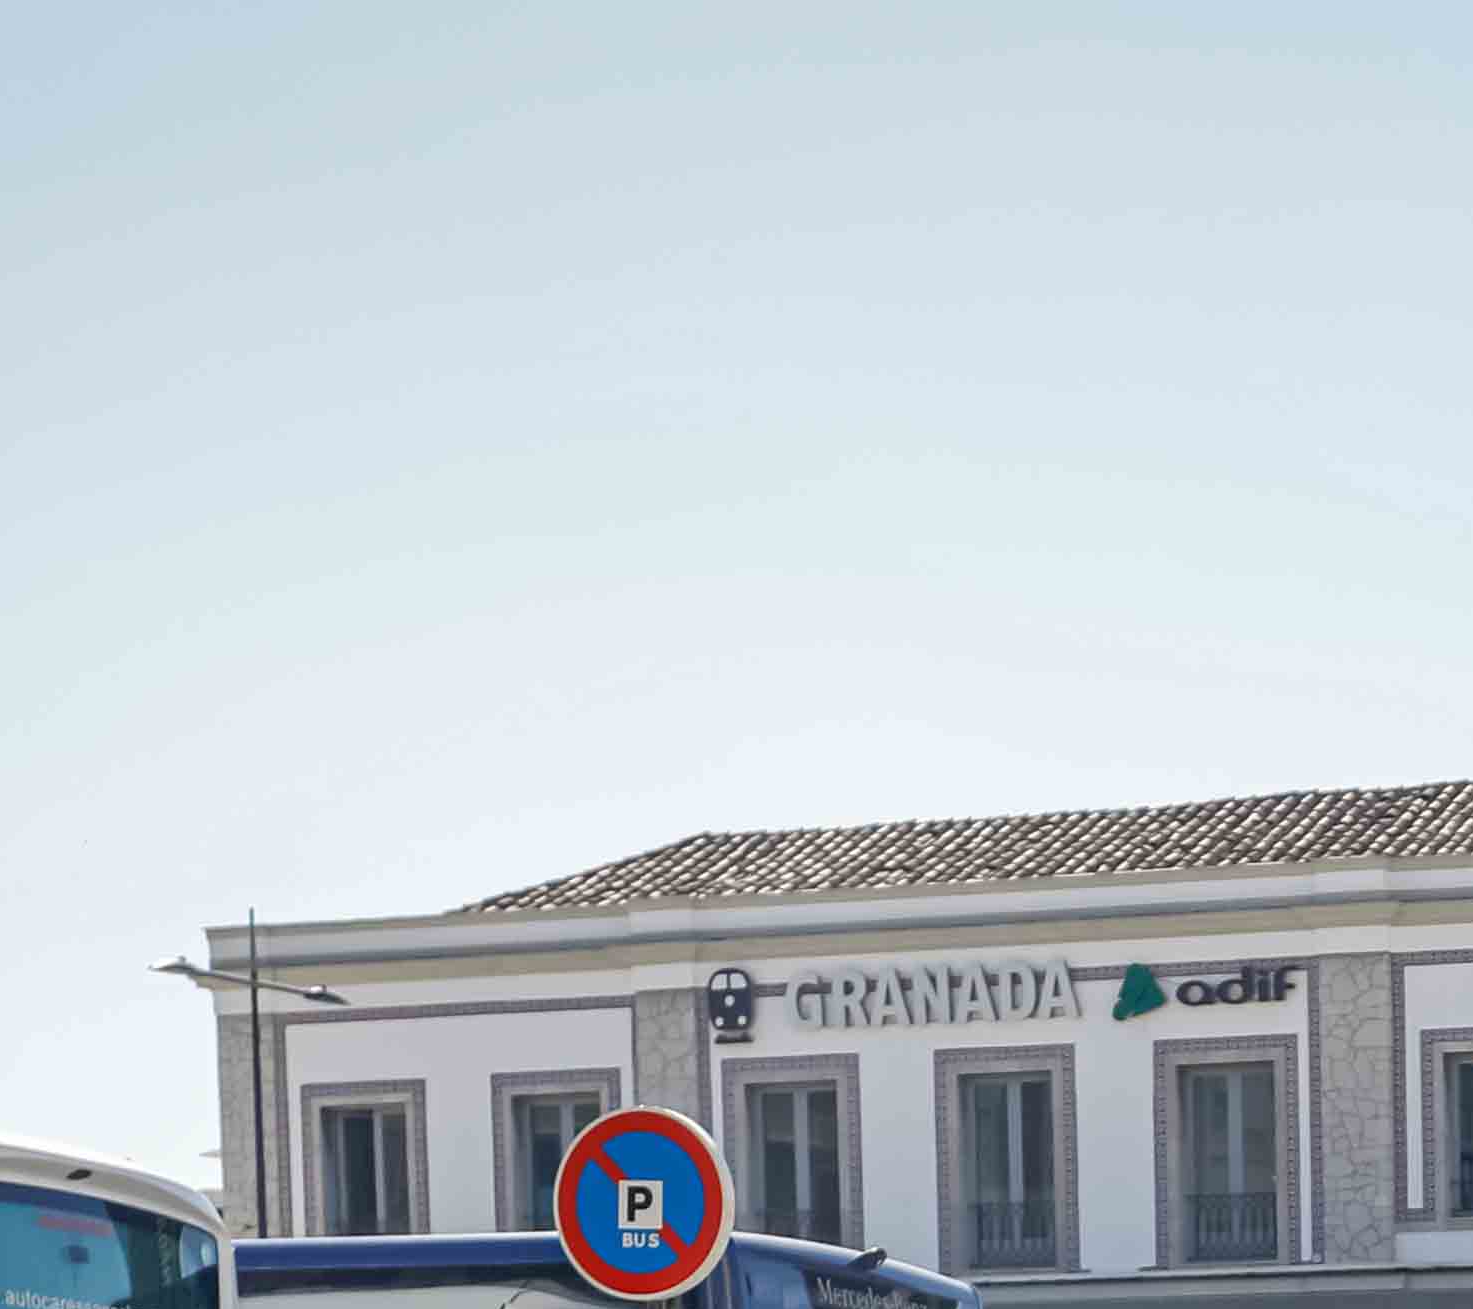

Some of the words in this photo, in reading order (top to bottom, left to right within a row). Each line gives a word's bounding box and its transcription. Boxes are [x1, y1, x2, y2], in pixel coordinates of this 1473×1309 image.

[784, 958, 1081, 1029] GRANADA
[1175, 966, 1301, 1007] adif
[627, 1186, 653, 1222] P
[622, 1232, 661, 1248] BUS
